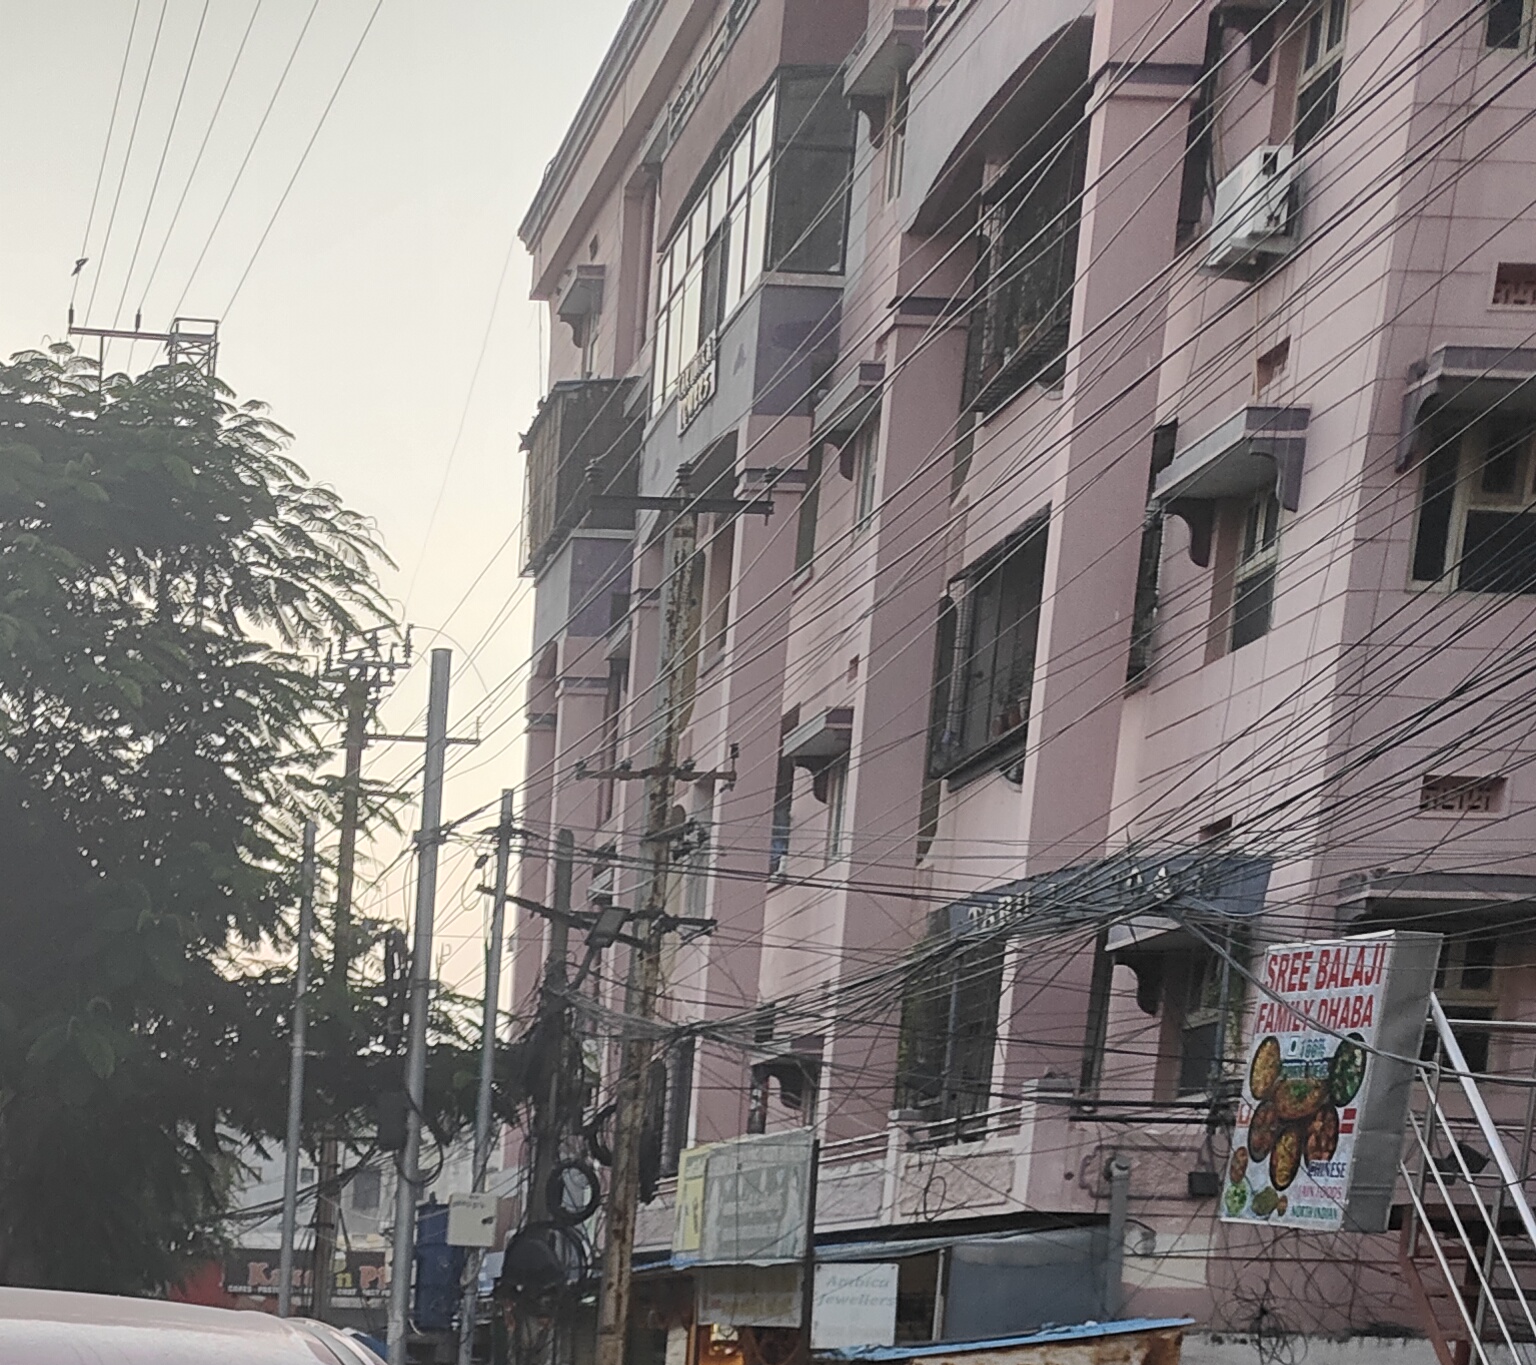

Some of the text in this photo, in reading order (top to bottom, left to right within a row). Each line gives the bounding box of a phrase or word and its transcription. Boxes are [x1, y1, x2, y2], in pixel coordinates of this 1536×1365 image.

[1265, 942, 1387, 993] SREE BALAJI
[1255, 994, 1374, 1034] FAMILY DHABA
